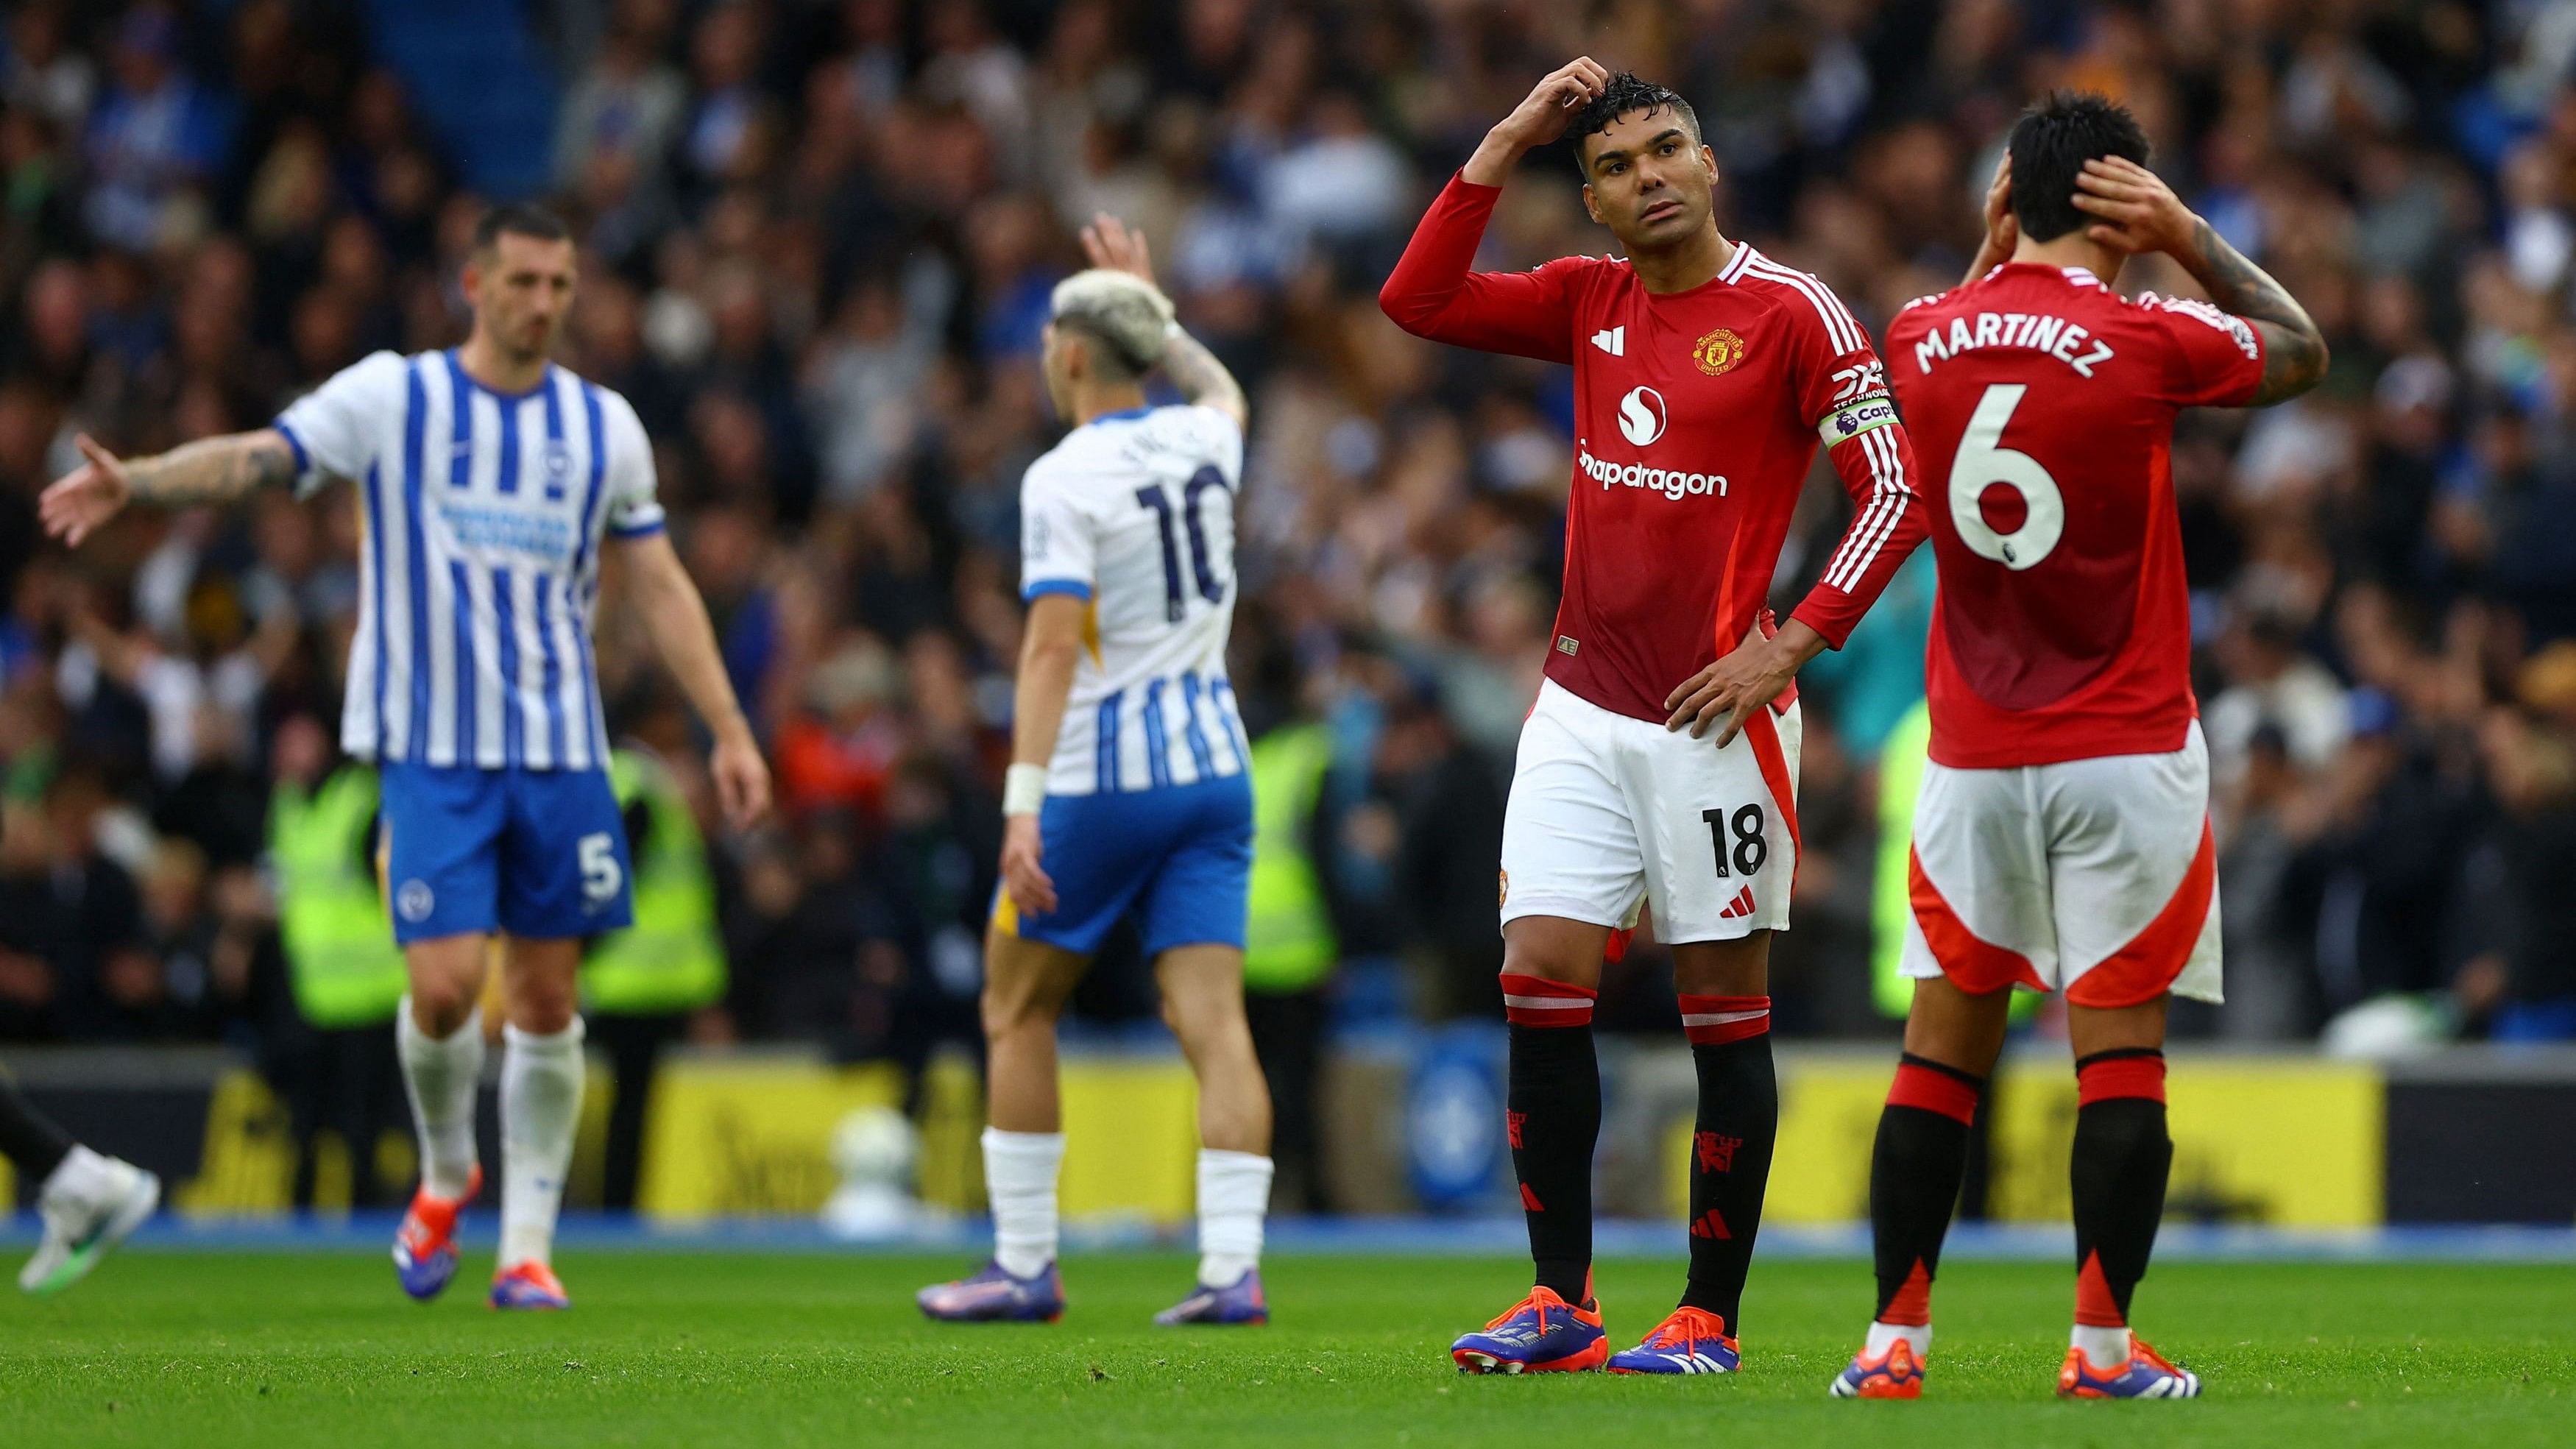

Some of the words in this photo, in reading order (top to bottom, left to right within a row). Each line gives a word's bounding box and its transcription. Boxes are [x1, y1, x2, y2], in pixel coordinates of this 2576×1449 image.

[1699, 331, 1740, 349] MANCHESTER
[1700, 364, 1729, 372] UNITED
[1915, 313, 2115, 378] MARTINEZ
[1947, 383, 2065, 571] 6
[1136, 464, 1228, 623] 10
[578, 831, 623, 901] 5
[1702, 803, 1767, 878] 18
